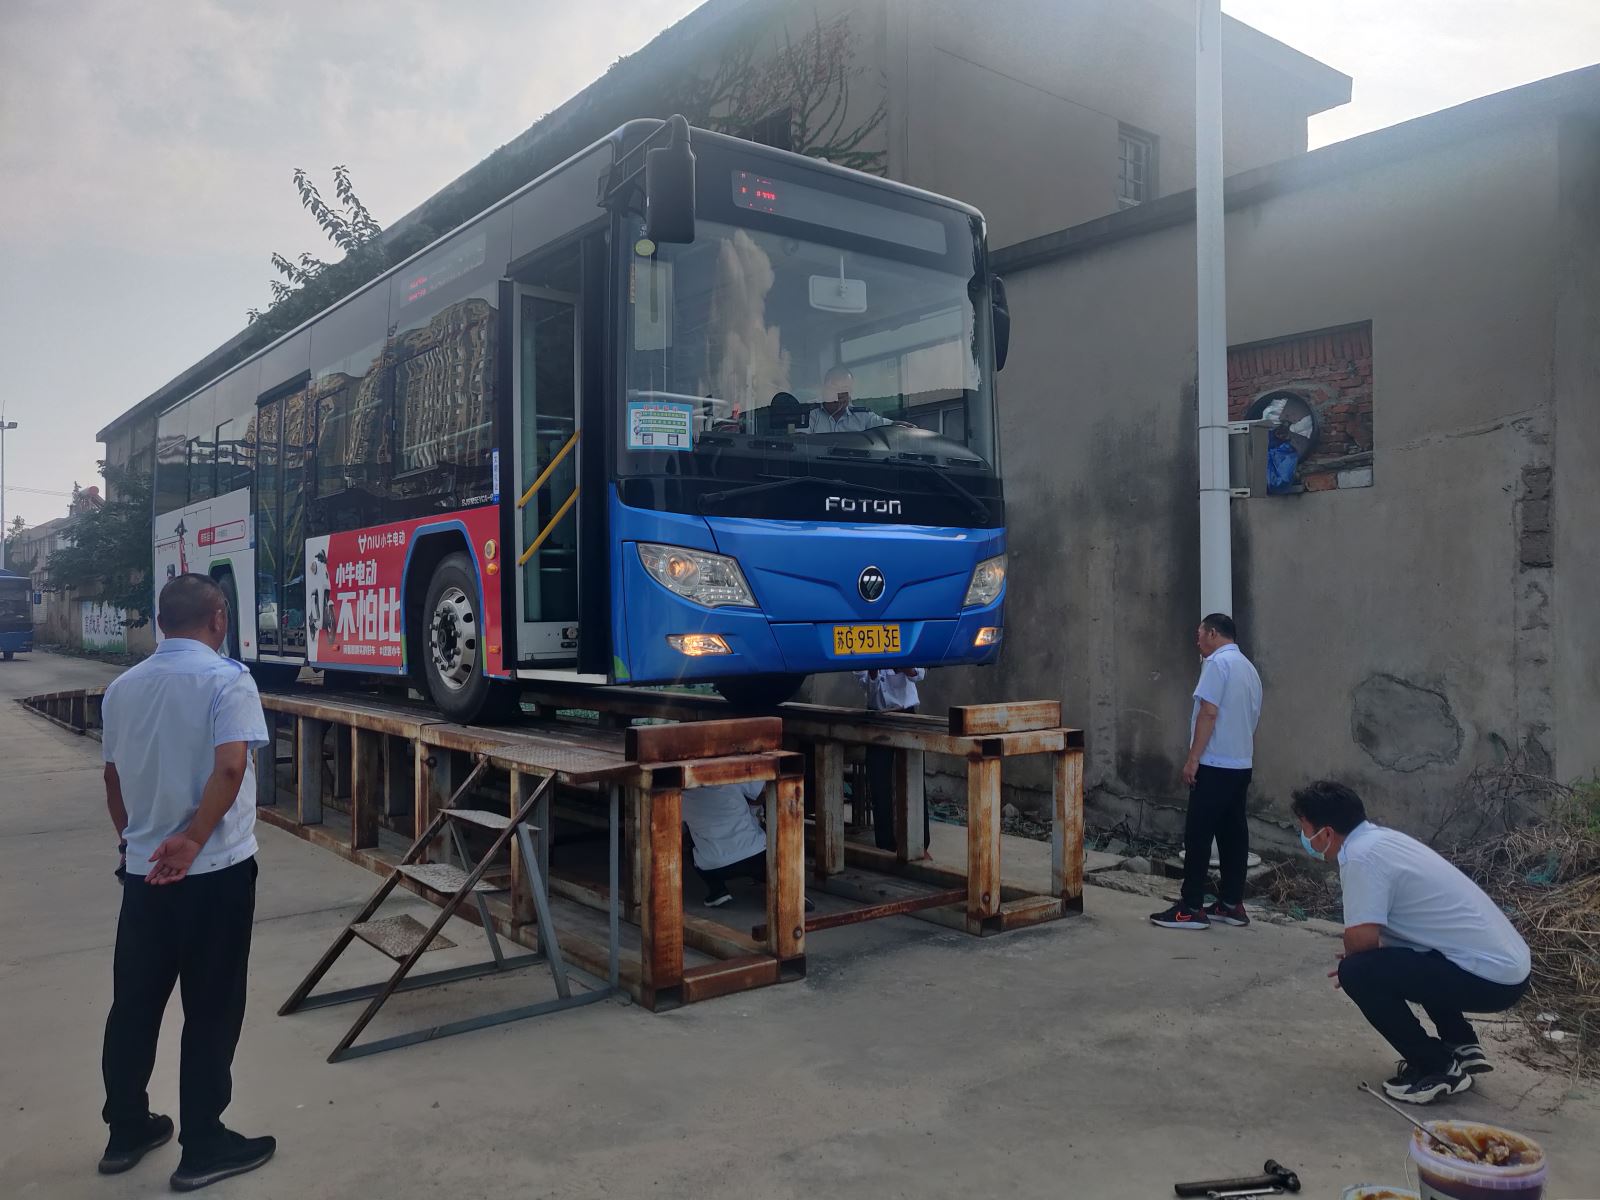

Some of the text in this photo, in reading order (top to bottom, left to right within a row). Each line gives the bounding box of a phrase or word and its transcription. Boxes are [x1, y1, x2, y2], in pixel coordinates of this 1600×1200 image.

[825, 496, 902, 515] FOTON
[335, 559, 377, 588] 小牛电动
[336, 587, 401, 641] 不怕比
